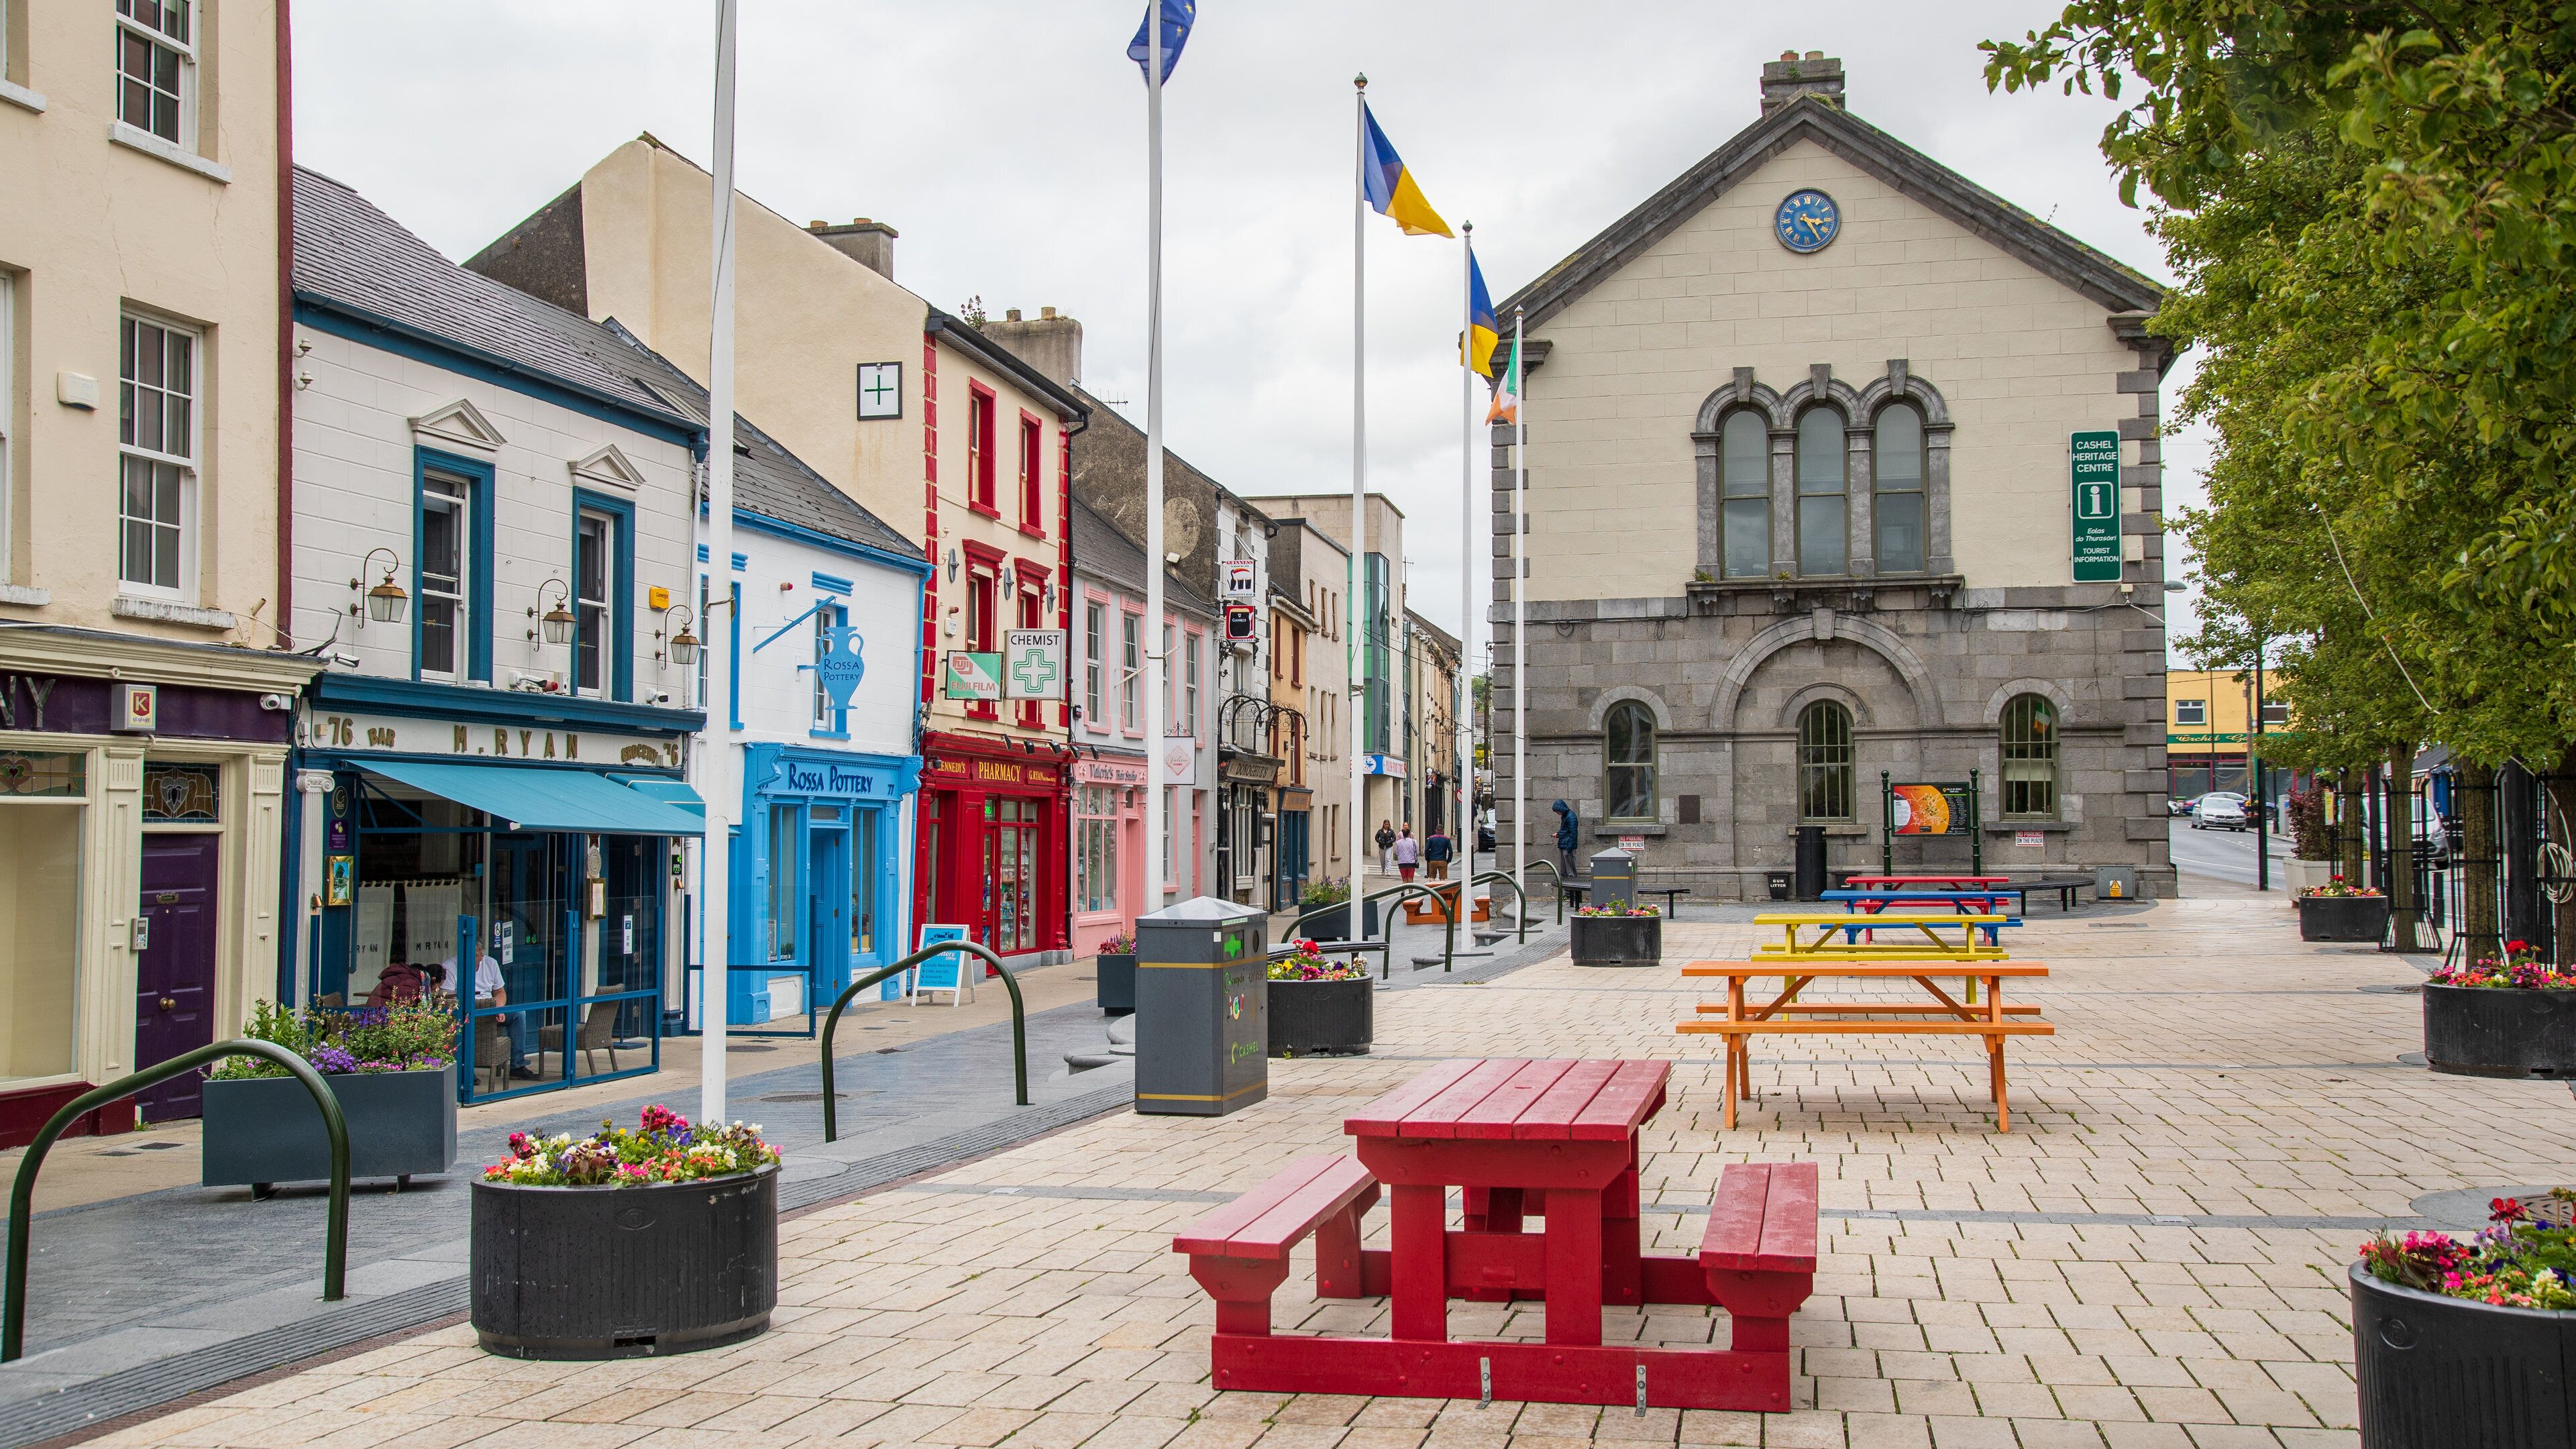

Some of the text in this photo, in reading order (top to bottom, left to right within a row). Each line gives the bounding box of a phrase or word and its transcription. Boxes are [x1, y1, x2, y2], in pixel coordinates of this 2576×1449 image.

[2076, 440, 2113, 449] CASHEL
[2072, 451, 2117, 462] HERITAGE
[2077, 463, 2114, 472] CENTRE
[1010, 635, 1059, 645] CHEMIST
[136, 696, 147, 712] K
[328, 716, 354, 745] 76
[368, 727, 396, 747] BAR
[621, 744, 659, 763] GROCERY
[663, 743, 679, 766] 76
[979, 761, 1021, 782] PHARMACY
[1236, 763, 1269, 778] DONOGHUE'S
[887, 784, 896, 796] 77
[1239, 1040, 1259, 1058] CASHEL
